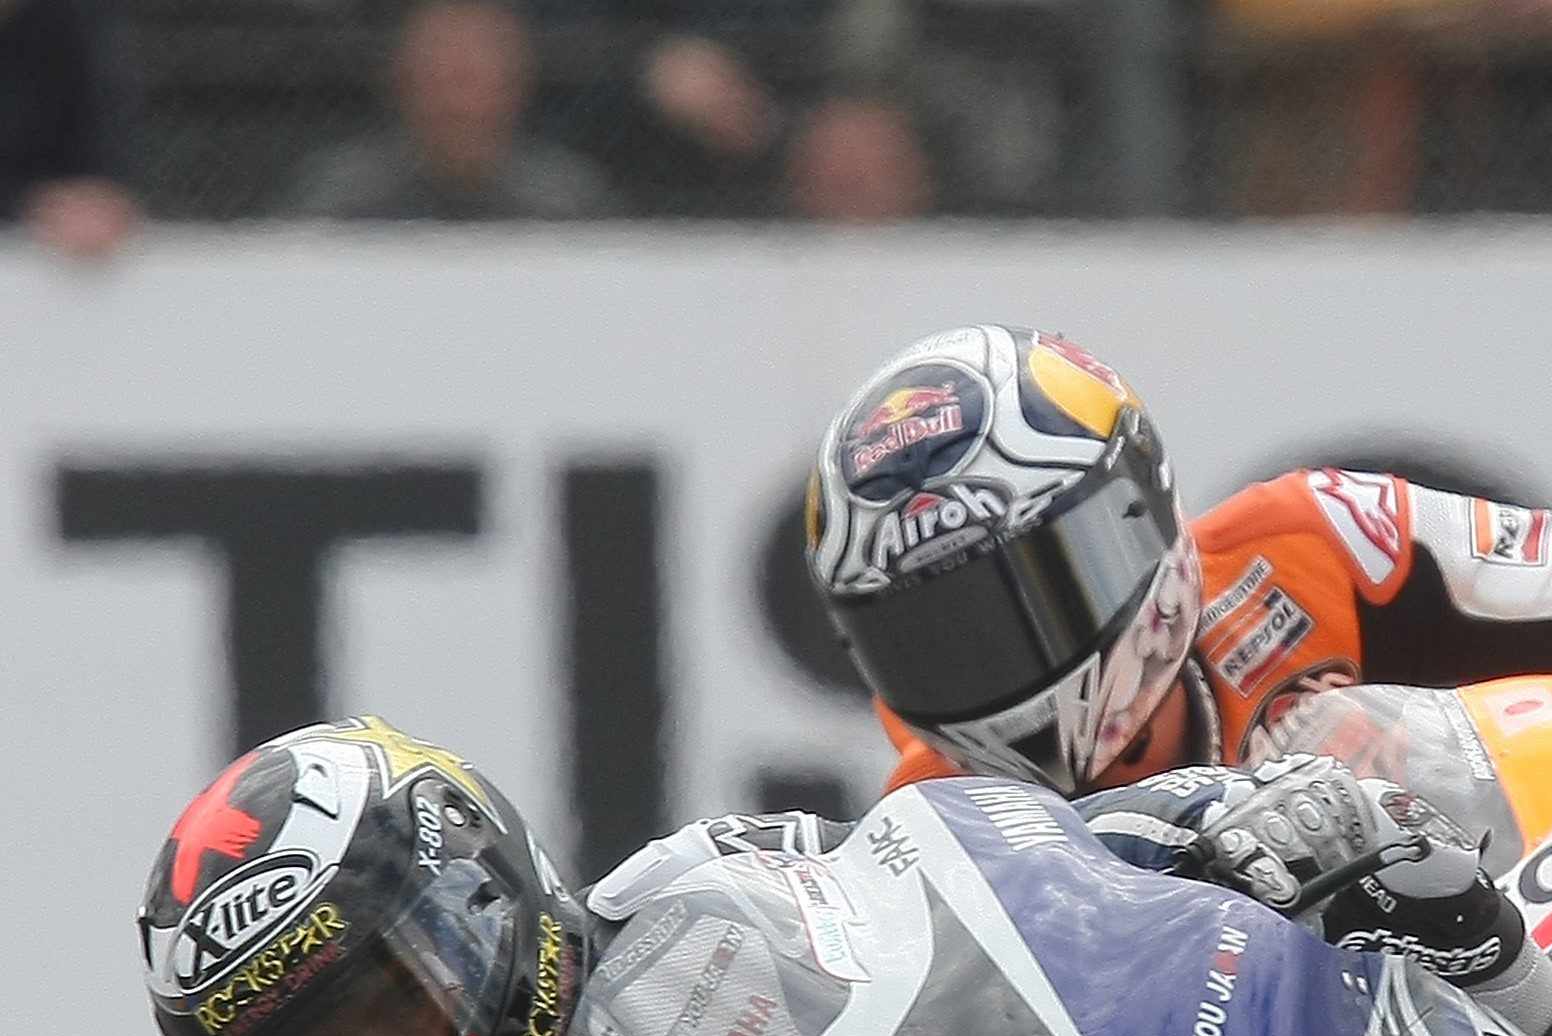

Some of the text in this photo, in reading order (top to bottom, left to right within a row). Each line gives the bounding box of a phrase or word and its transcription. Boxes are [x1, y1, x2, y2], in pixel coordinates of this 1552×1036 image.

[870, 483, 1007, 570] Airoh
[416, 795, 441, 876] X-802
[177, 867, 303, 972] X-lite
